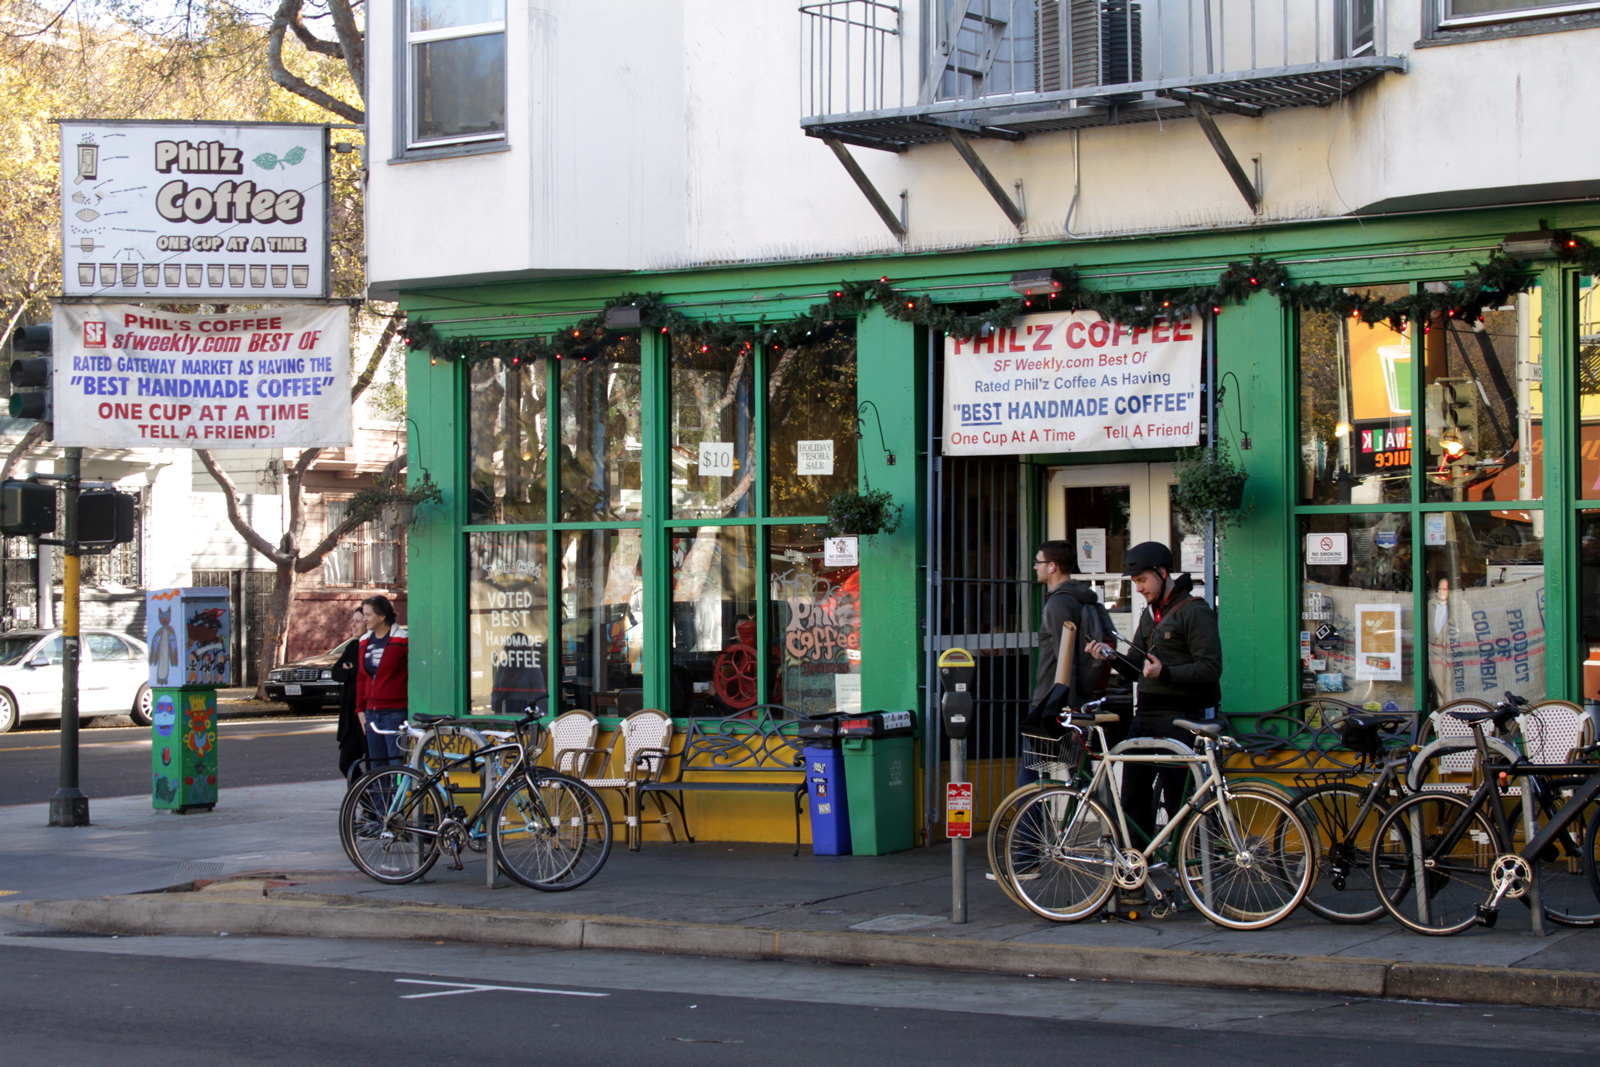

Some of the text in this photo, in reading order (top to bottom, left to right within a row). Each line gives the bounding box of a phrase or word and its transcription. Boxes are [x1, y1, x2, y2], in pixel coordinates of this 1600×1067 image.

[155, 140, 243, 174] Philz
[156, 180, 304, 224] Coffee
[157, 236, 306, 252] ONE CUP AT A TIME
[86, 322, 104, 342] SF
[124, 313, 282, 332] PHIL'S COFFEE
[112, 330, 322, 354] sfweekly.com BEST OF
[1066, 318, 1193, 350] COFFEE
[73, 356, 332, 375] RATED GATEWAY MARKET AS HAVING THE
[994, 351, 1148, 372] SF Weekly.com Best Of
[138, 377, 248, 398] HANDMADE
[974, 372, 1171, 392] Rated Phil'z Coffee As Having
[98, 402, 309, 421] ONE CUP AT A TIME
[953, 392, 1195, 422] "BEST HANDMADE COFFEE"
[138, 424, 276, 439] TELL A FRIEND!
[950, 429, 1076, 446] One Cup At A Time
[1104, 422, 1194, 438] Tell A Friend!
[800, 444, 832, 452] HOLIDAY
[801, 452, 830, 460] TESORA
[702, 450, 730, 468] $10
[806, 462, 824, 470] SALE
[487, 592, 532, 608] VOTED
[491, 610, 530, 627] BEST
[786, 626, 858, 660] Coffee
[1472, 610, 1498, 692] COLOMBIA
[1495, 638, 1512, 660] OF
[1506, 608, 1530, 683] PRODUCT
[491, 650, 541, 668] COFFEE
